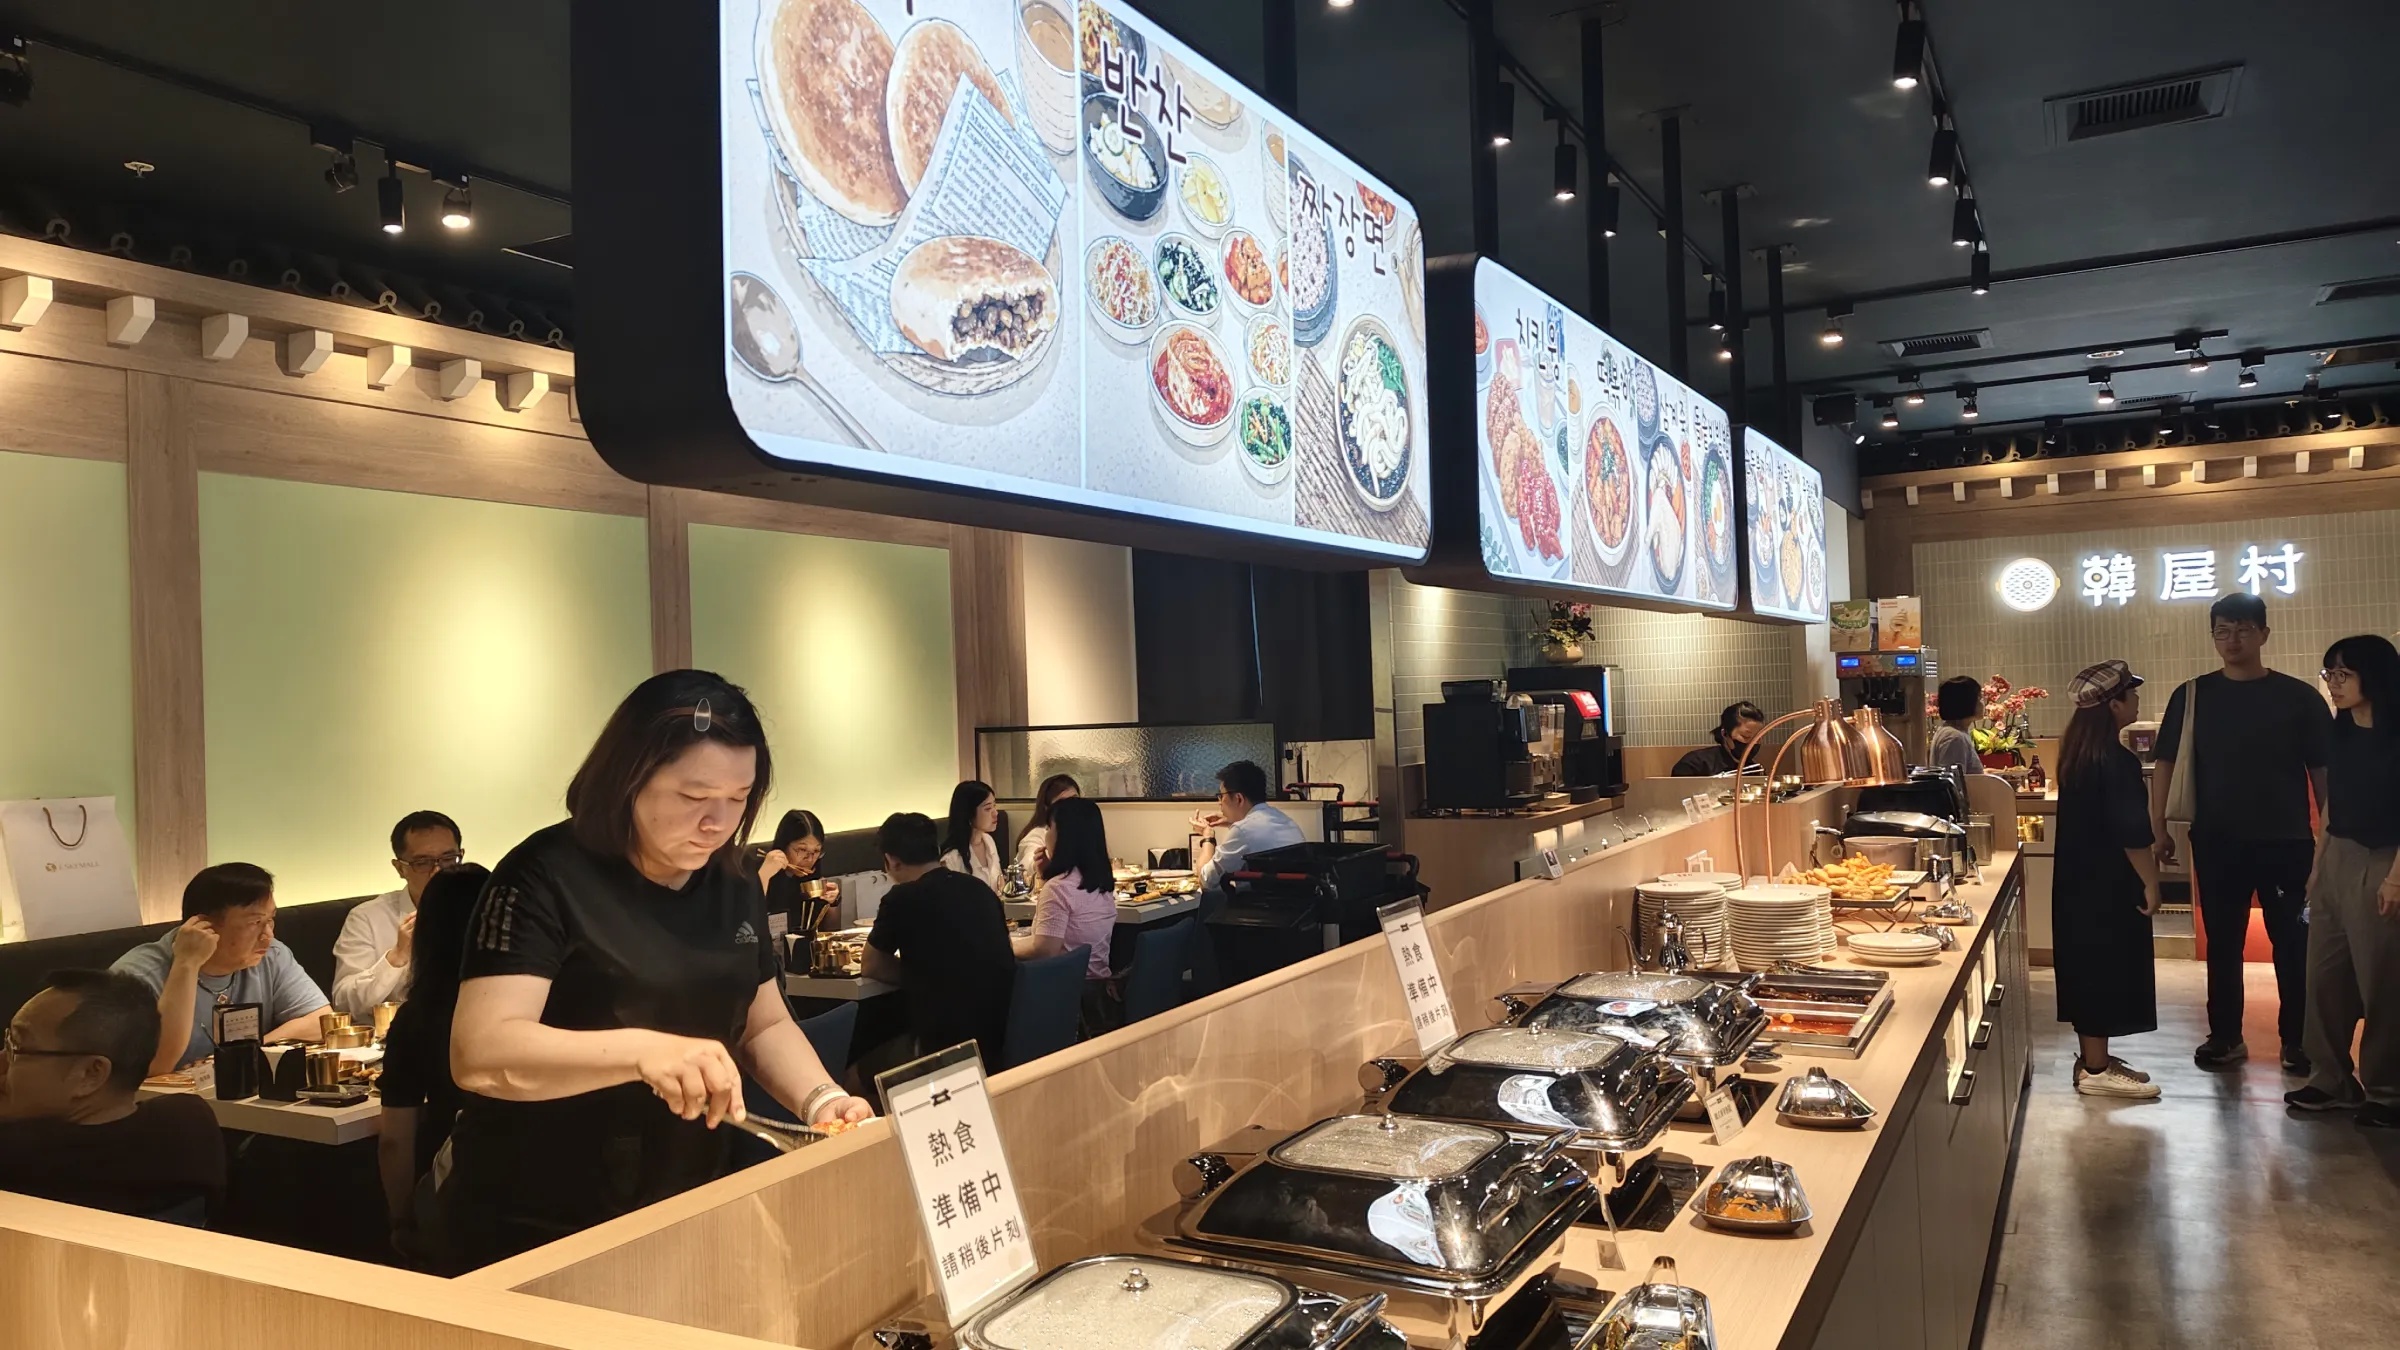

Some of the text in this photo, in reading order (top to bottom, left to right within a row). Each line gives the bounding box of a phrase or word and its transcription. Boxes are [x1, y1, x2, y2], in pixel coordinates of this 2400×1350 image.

[1102, 43, 1193, 165] 반찬
[1300, 175, 1387, 277] 짜장면
[1516, 307, 1560, 381] 치킨윙
[1597, 360, 1631, 410] 떡볶이
[2081, 543, 2304, 607] 韓屋村
[928, 1119, 976, 1167] 熱食
[932, 1170, 1002, 1229] 準備中
[941, 1216, 1021, 1280] 請稍後片刻
